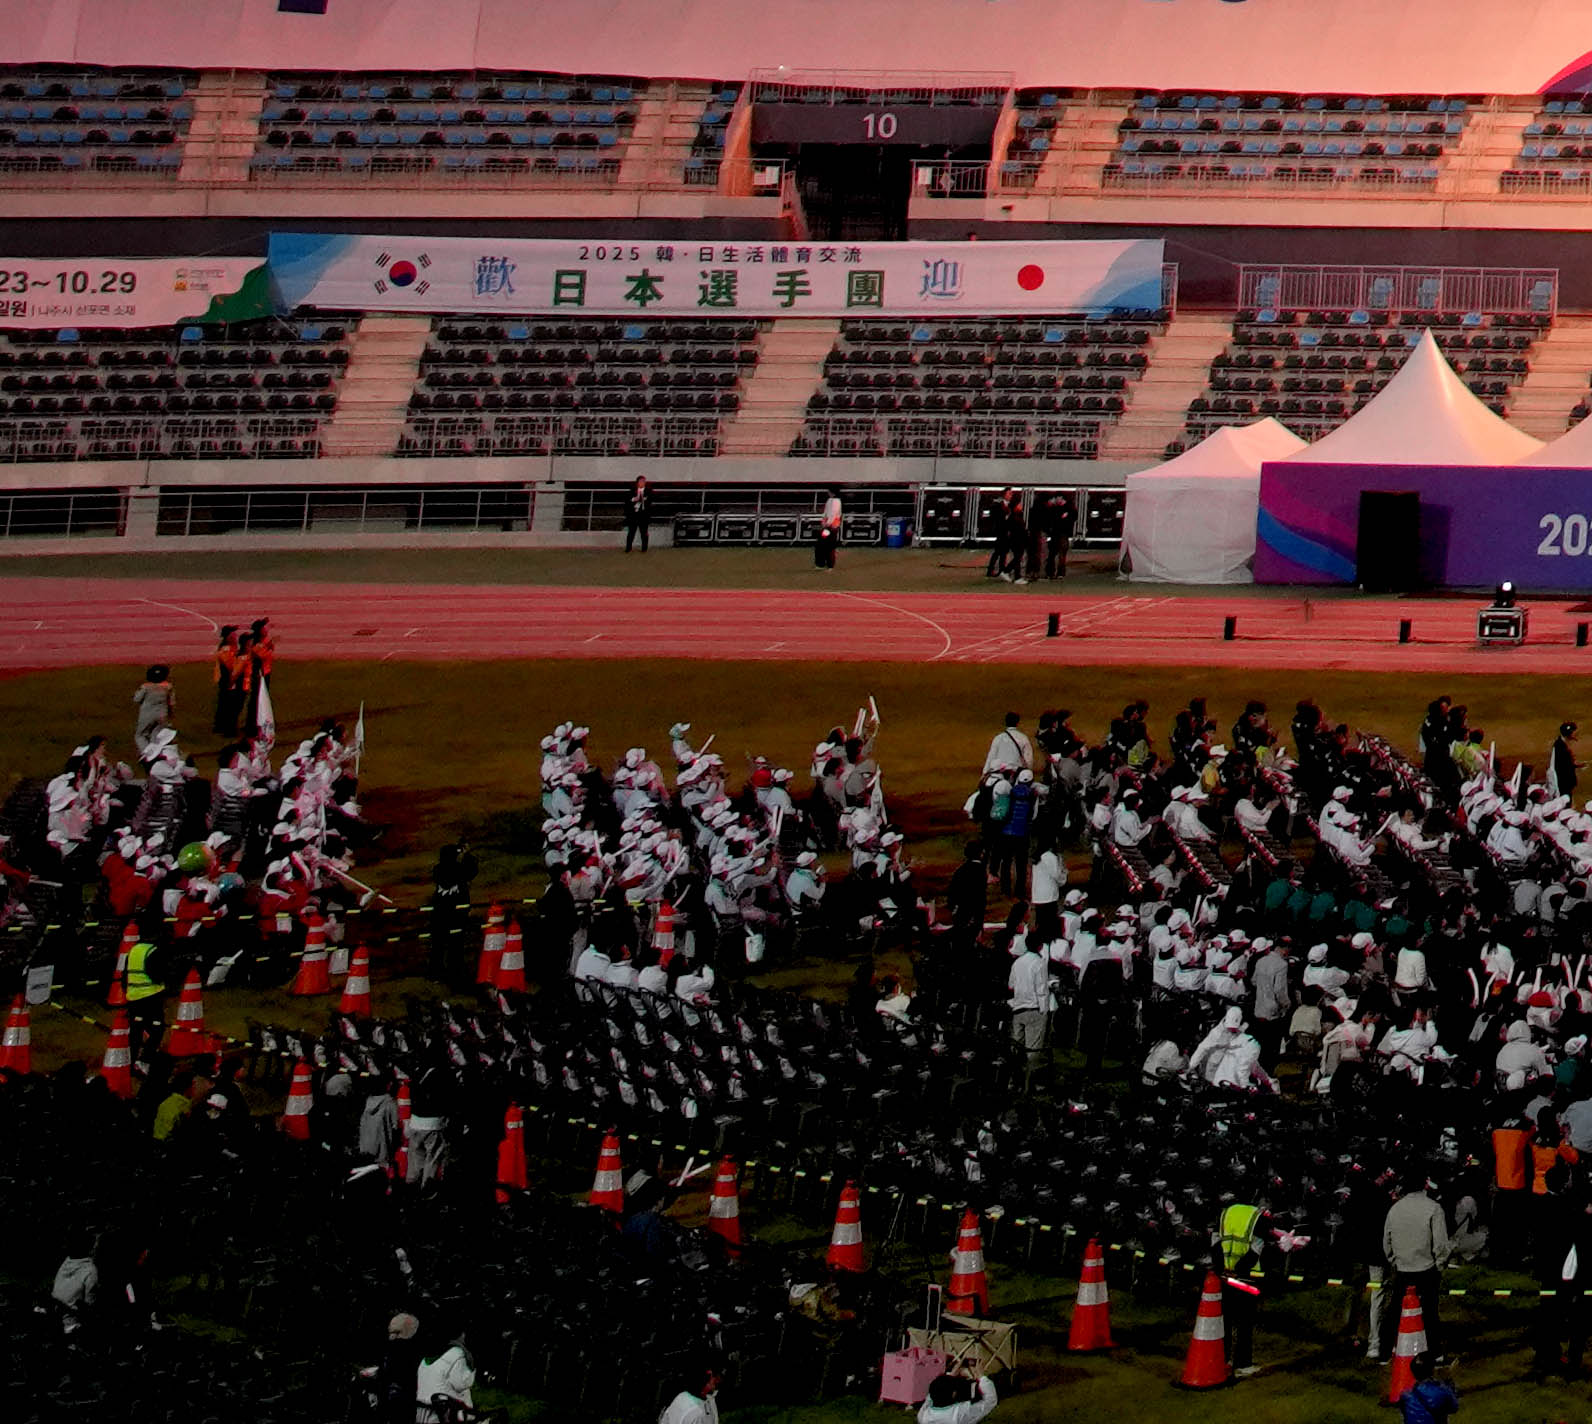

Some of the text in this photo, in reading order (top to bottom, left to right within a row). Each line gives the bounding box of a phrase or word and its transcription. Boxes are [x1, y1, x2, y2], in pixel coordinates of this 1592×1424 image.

[863, 112, 897, 138] 10
[579, 246, 640, 262] 2025
[553, 267, 885, 309] 日本選手團
[918, 257, 963, 300] 迎
